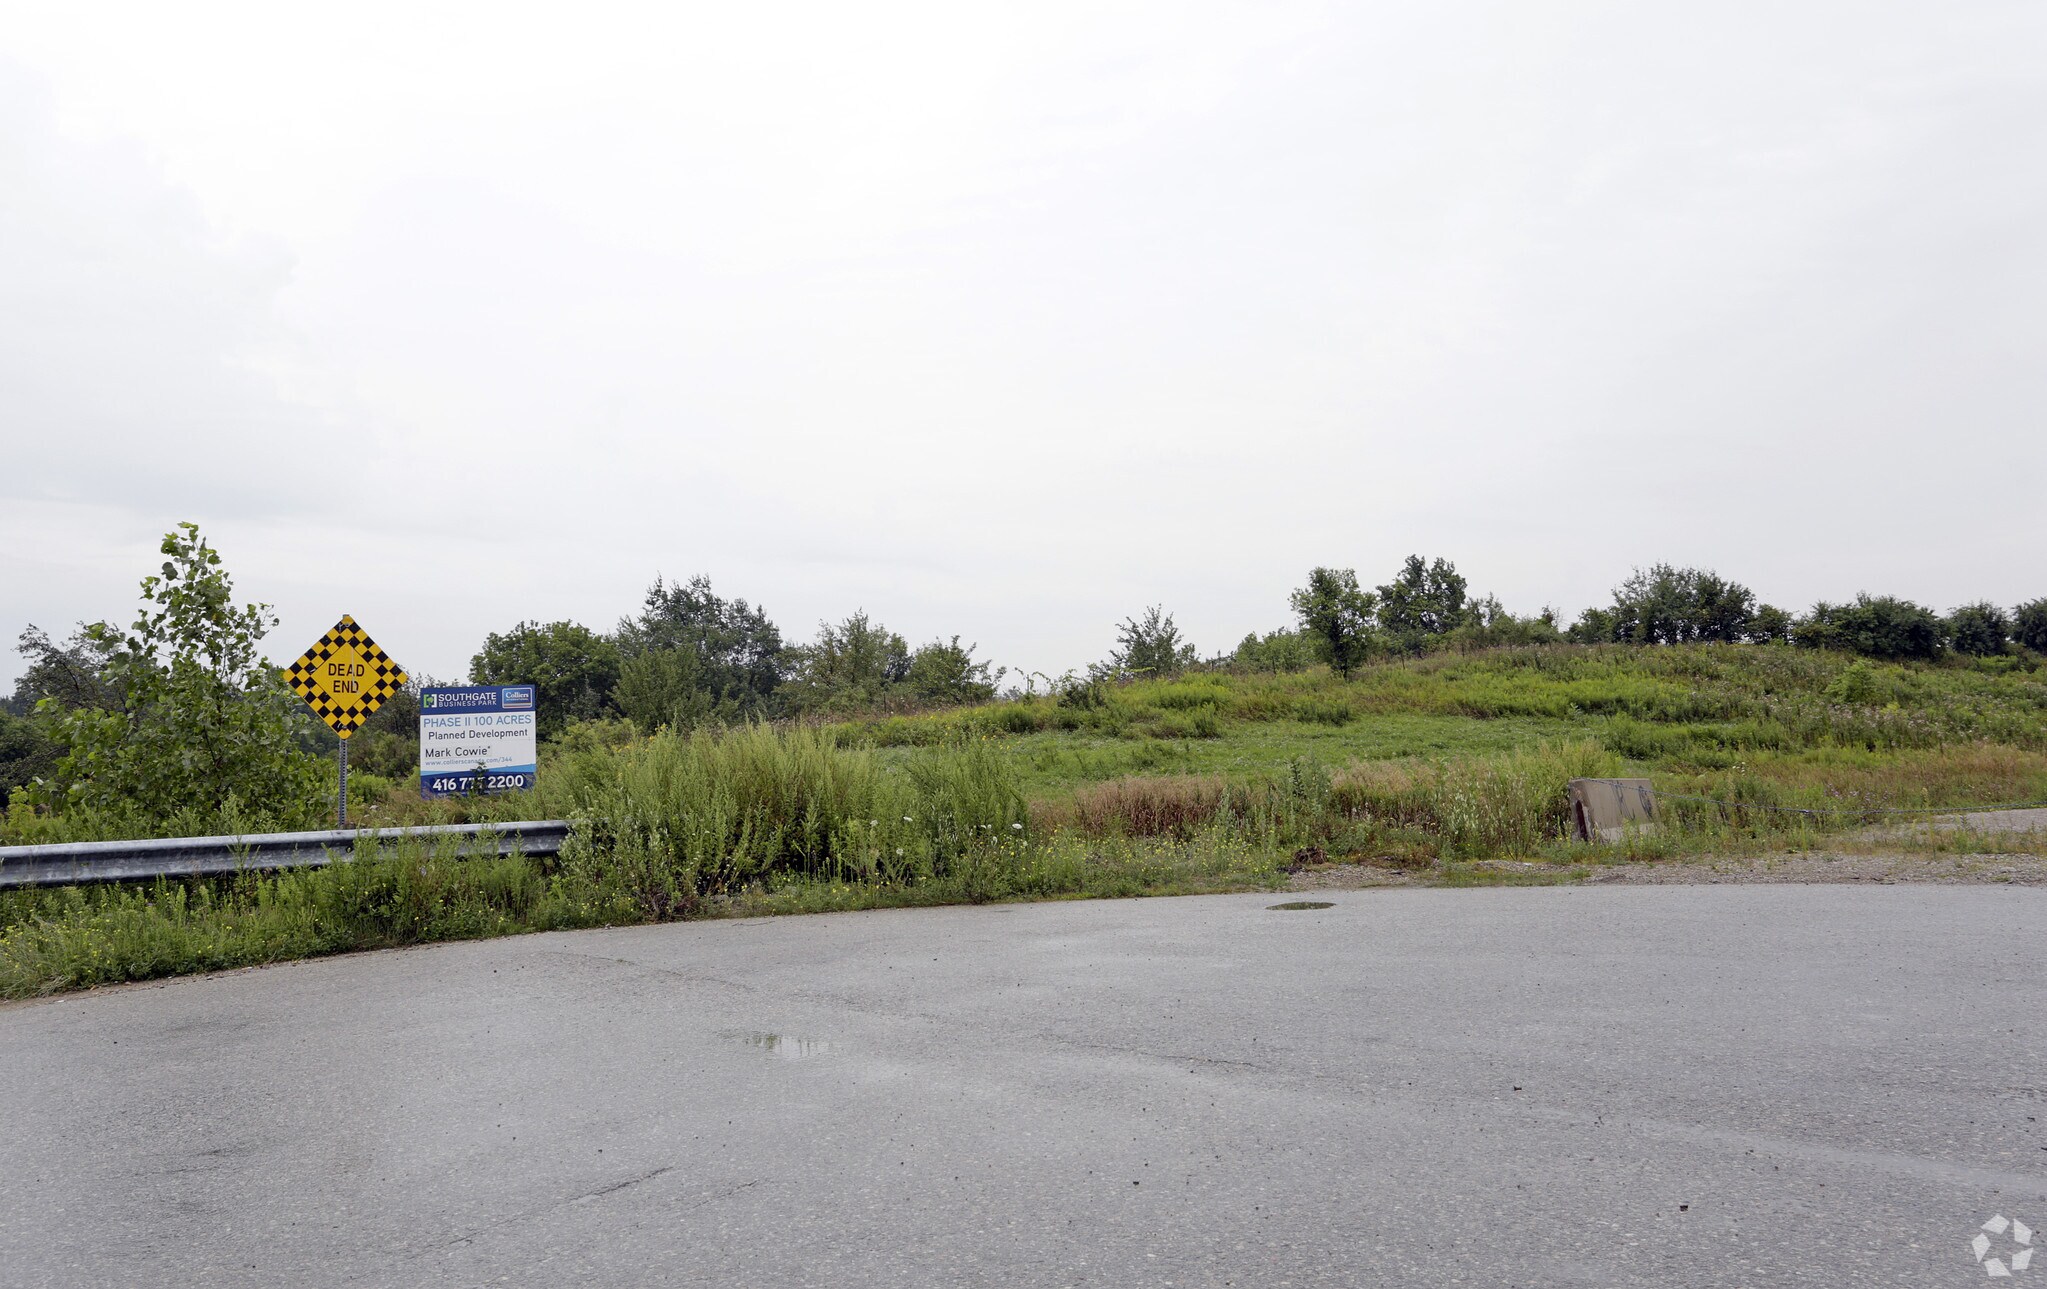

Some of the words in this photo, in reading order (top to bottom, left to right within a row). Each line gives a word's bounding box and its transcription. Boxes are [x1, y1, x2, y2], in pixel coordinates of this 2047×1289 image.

[328, 663, 365, 677] DEAD
[333, 680, 359, 693] END
[438, 692, 497, 701] SOUTHGATE
[505, 691, 529, 699] Colliers
[439, 700, 476, 708] BUSINESS
[423, 717, 461, 728] PHASE
[464, 717, 471, 727] II
[475, 716, 493, 726] 100
[496, 714, 532, 725] ACRES
[428, 731, 466, 740] Planned
[468, 729, 528, 740] Development
[425, 748, 451, 757] Mark
[432, 778, 457, 791] 416
[487, 775, 524, 789] 2200
